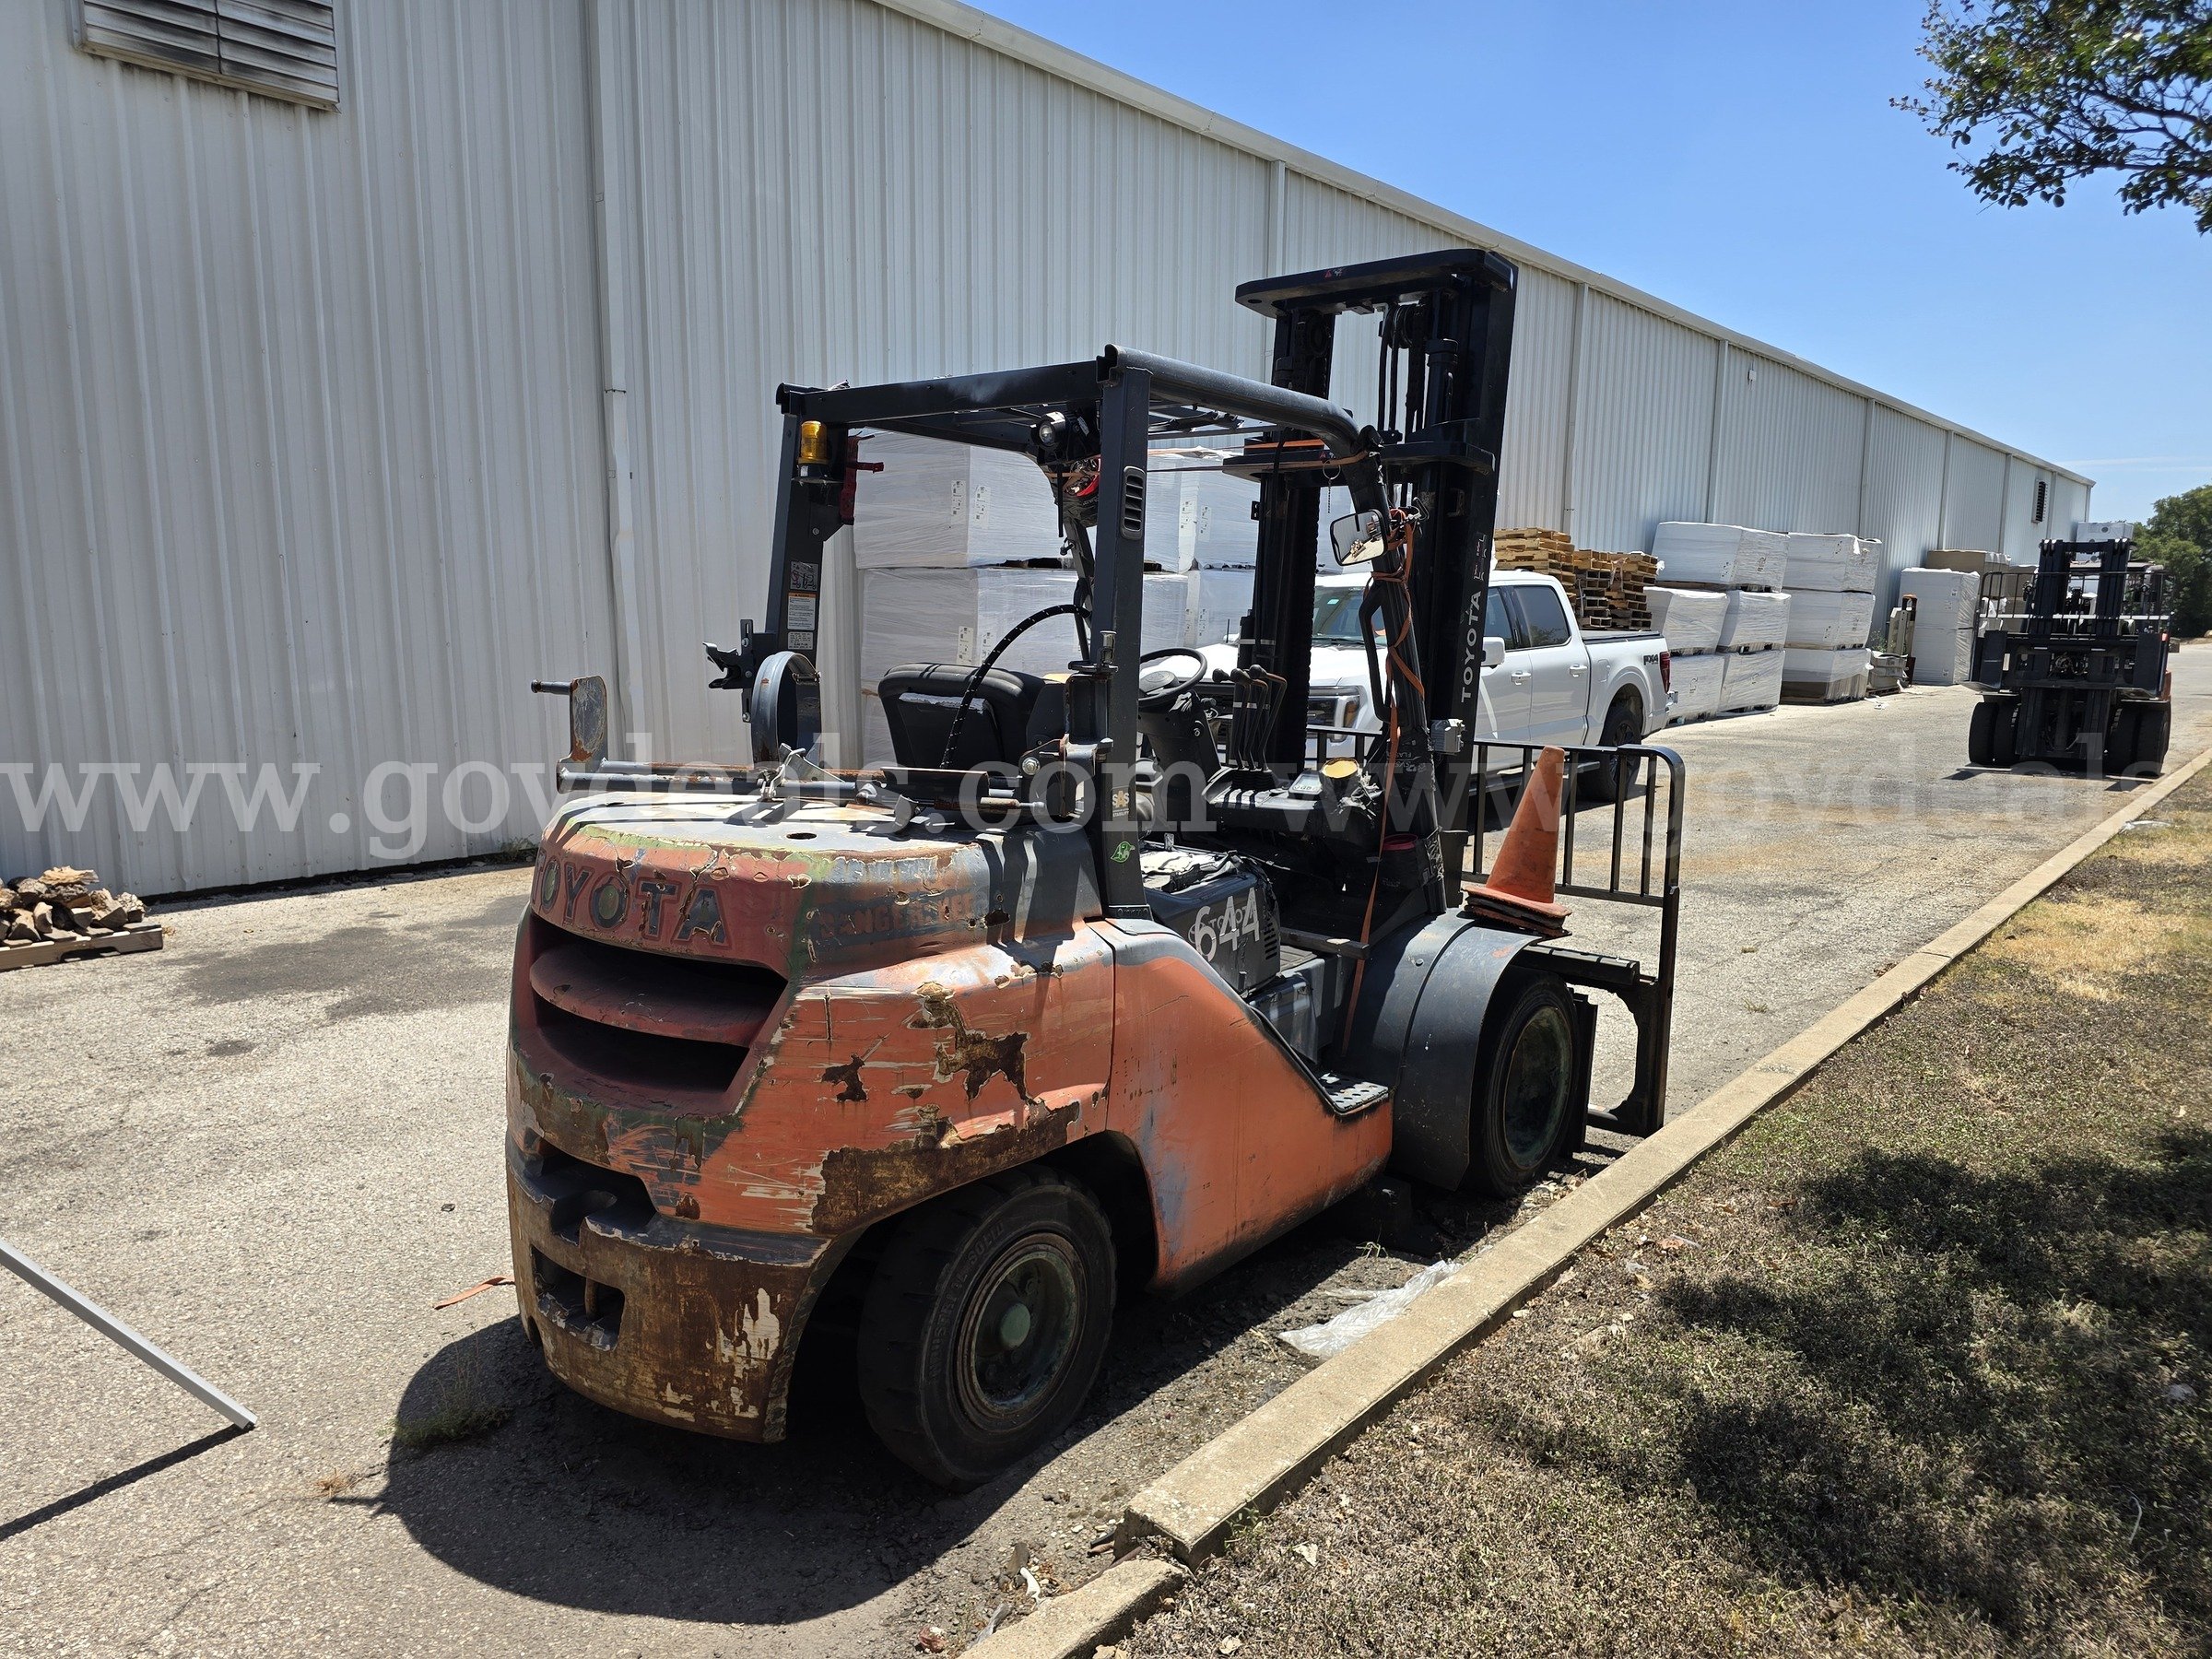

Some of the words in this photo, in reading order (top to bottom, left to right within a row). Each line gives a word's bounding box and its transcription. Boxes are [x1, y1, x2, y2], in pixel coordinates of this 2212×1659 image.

[1461, 591, 1481, 703] TOYOTA
[1112, 790, 1130, 808] SAS
[1194, 887, 1260, 962] 644
